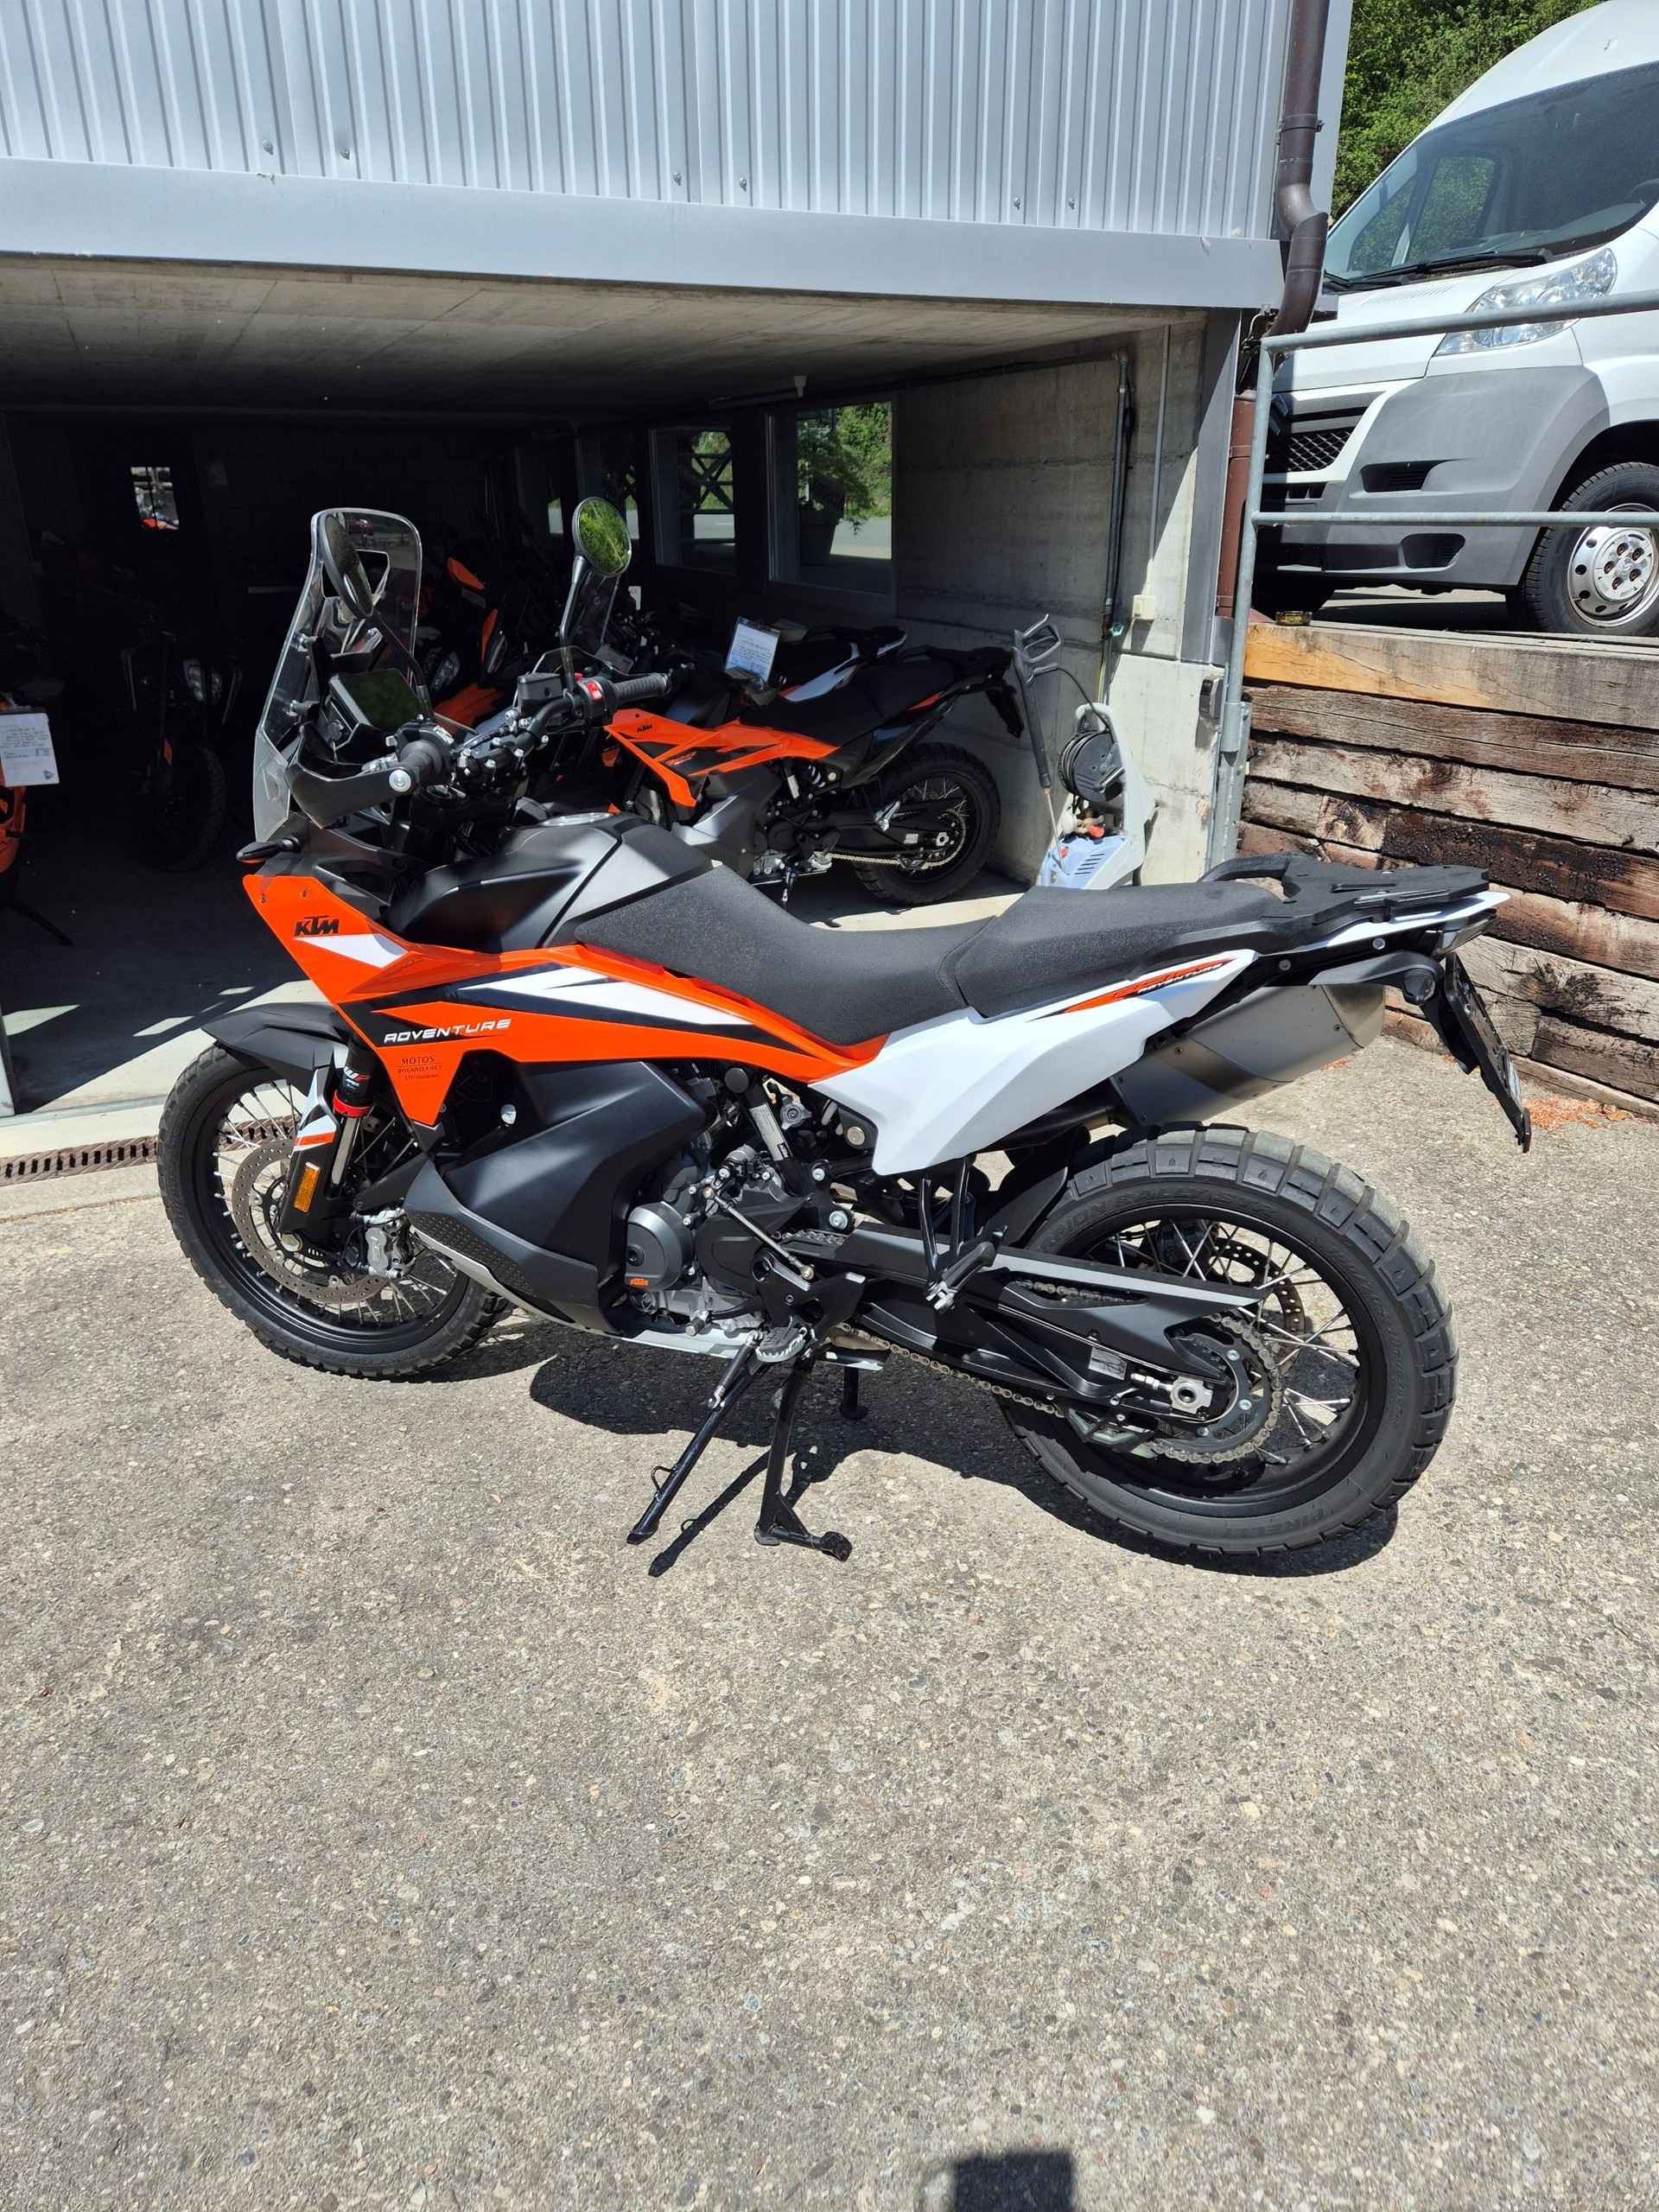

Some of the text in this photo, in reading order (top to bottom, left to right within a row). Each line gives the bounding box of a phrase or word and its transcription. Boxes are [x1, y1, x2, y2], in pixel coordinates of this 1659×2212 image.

[294, 915, 340, 936] KTM
[384, 1018, 512, 1044] ADVENTURE
[402, 1056, 435, 1065] MOTOS
[1115, 1185, 1209, 1208] RALLY
[1215, 1191, 1277, 1218] STR
